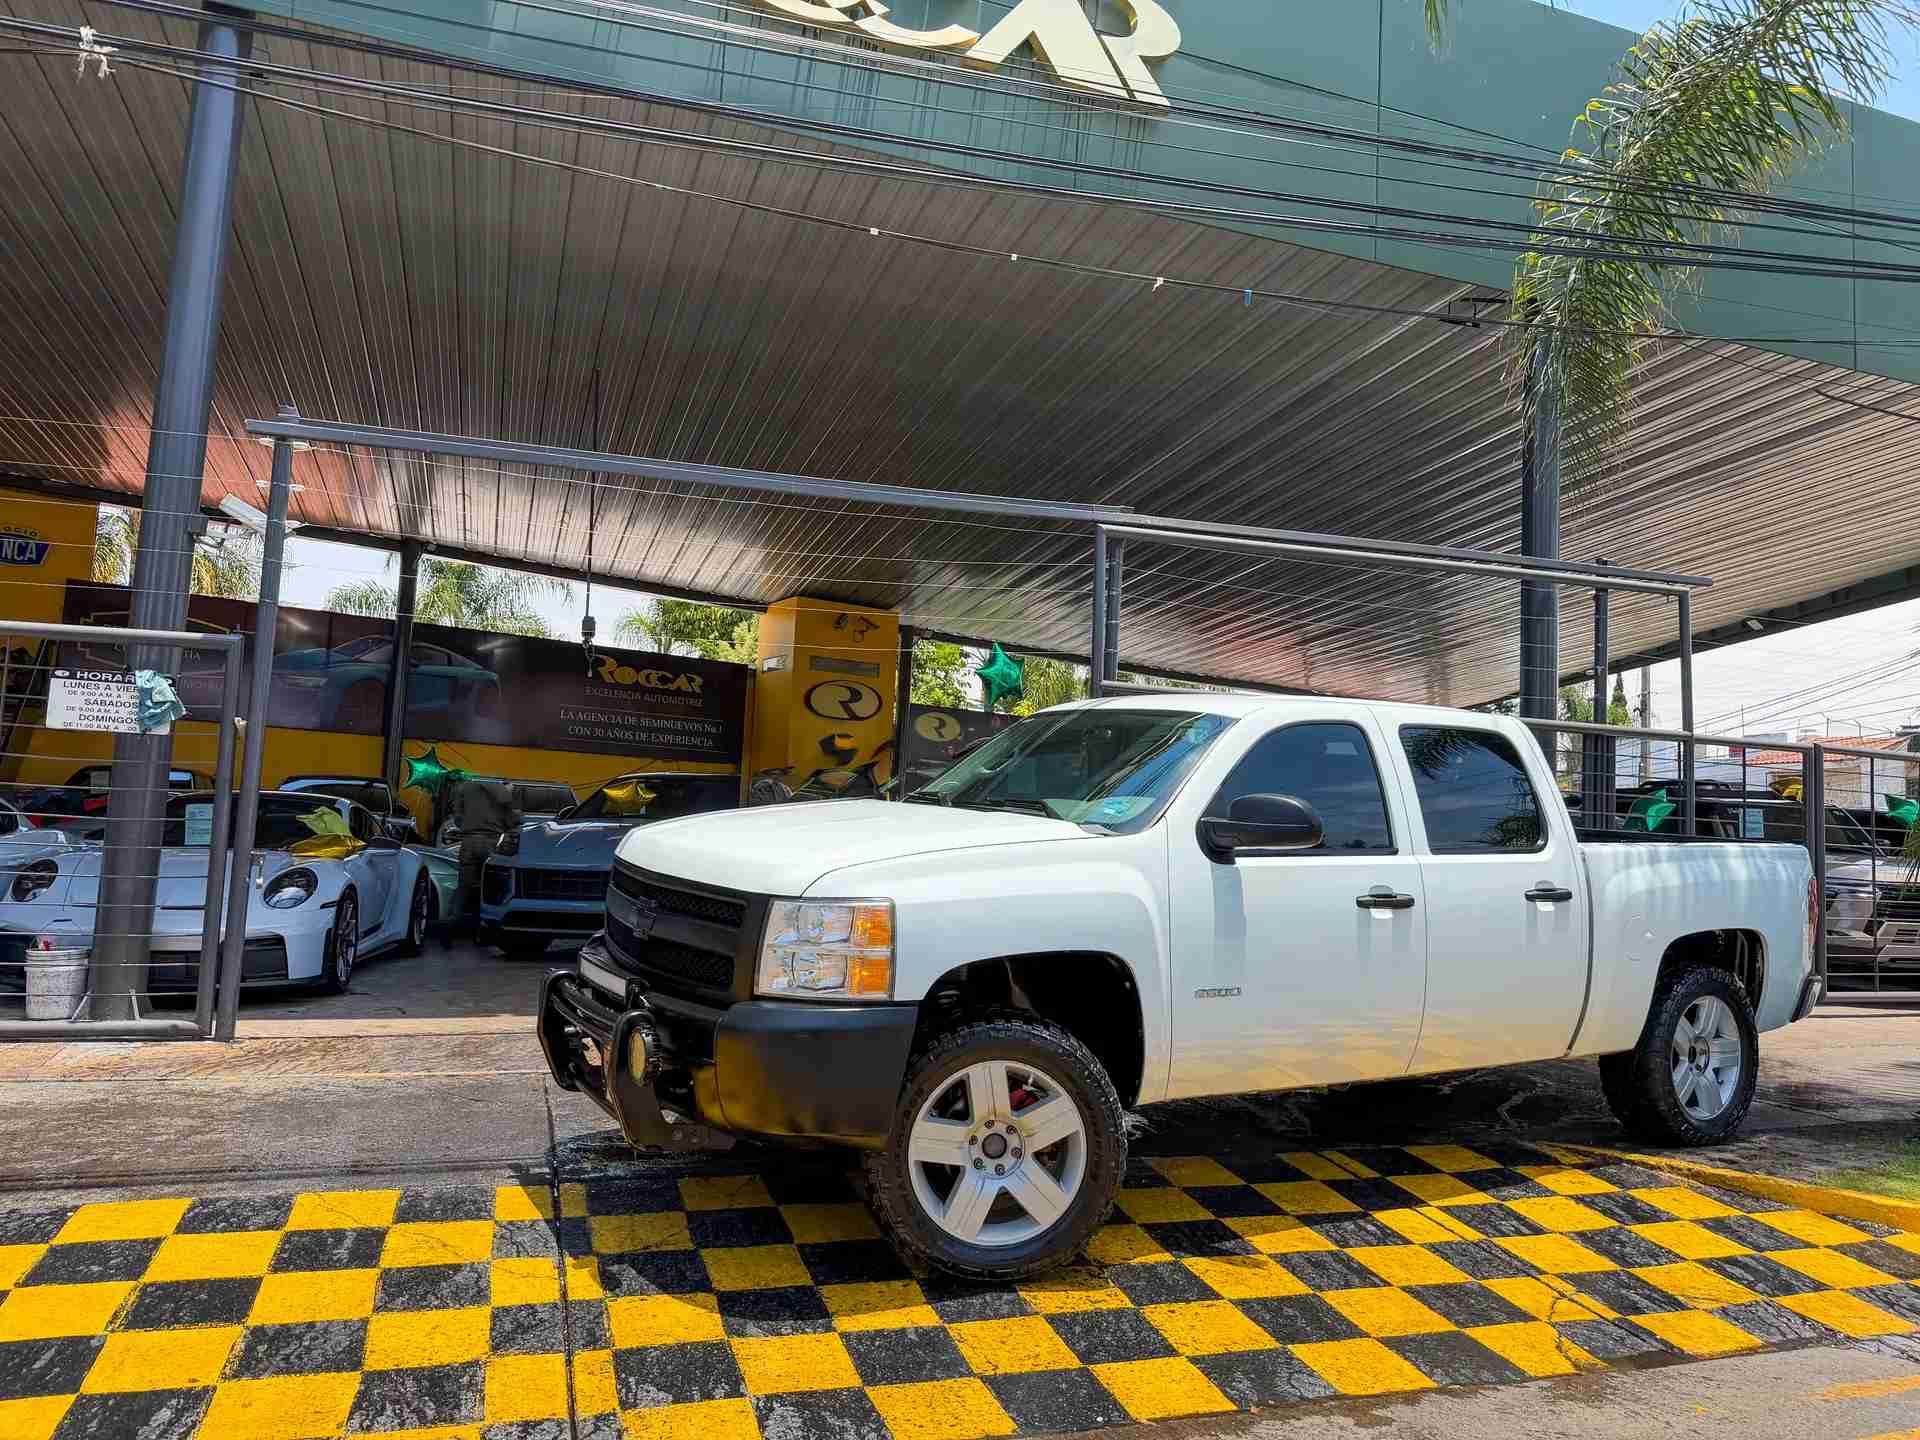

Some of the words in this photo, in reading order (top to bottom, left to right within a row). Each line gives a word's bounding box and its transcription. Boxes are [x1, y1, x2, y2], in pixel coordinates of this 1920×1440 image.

[63, 681, 101, 690] LUNES
[104, 684, 112, 692] A
[560, 709, 575, 721] LA
[576, 711, 624, 726] AGENCIA
[625, 715, 637, 727] DE
[640, 719, 703, 733] SEMINUEVOS
[568, 726, 592, 738] CON
[606, 726, 634, 742] AÑOS
[651, 733, 713, 747] EXPERIENCIA
